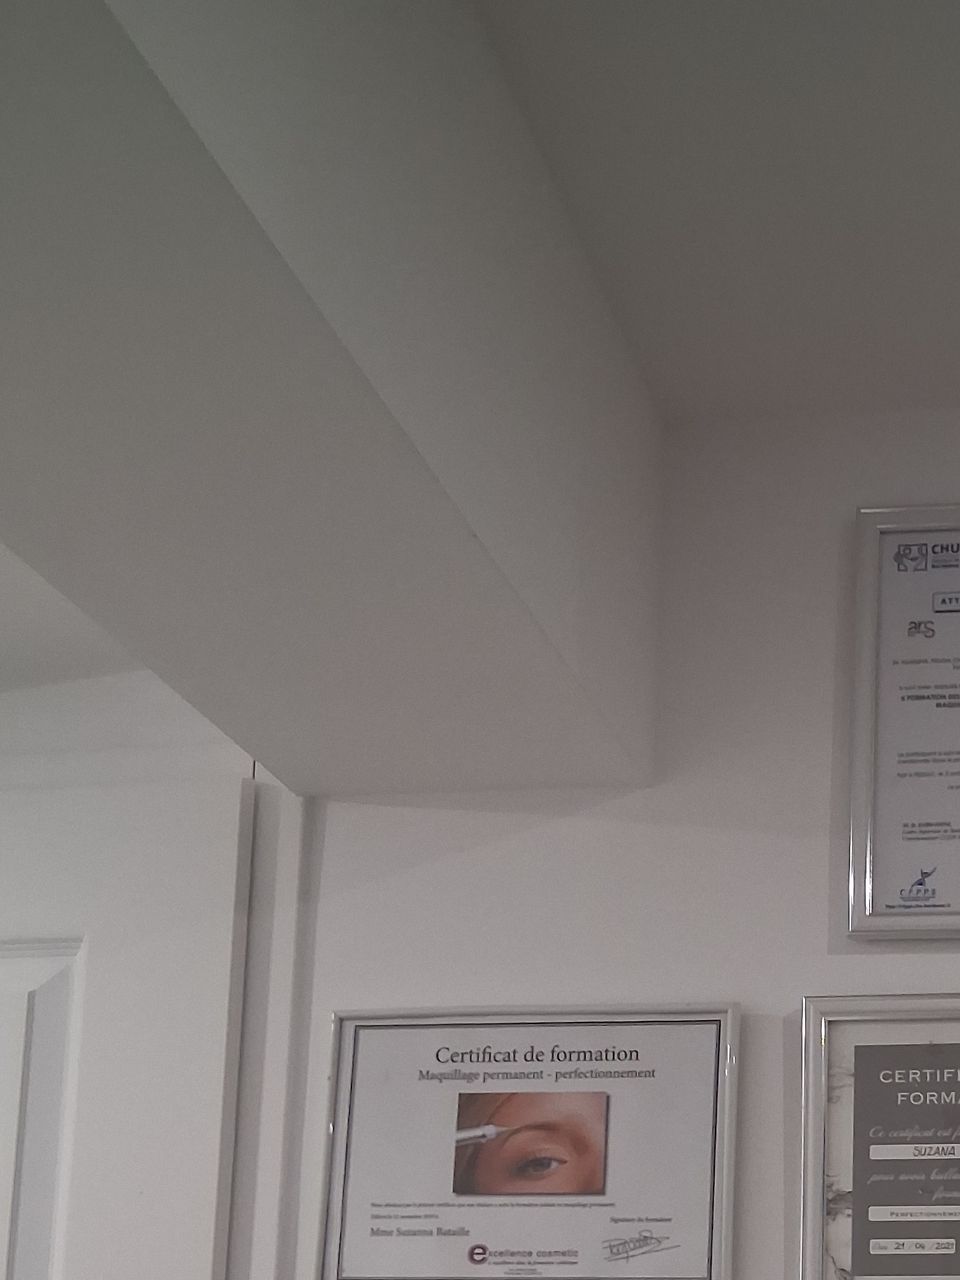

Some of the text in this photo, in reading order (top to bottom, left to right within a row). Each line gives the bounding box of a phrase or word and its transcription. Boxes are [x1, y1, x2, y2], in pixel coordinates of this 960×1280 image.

[931, 543, 960, 555] CHU
[907, 619, 936, 638] ars
[435, 1044, 640, 1065] Certificat de formation
[418, 1068, 480, 1084] Maquillage
[483, 1070, 543, 1083] permanent
[555, 1067, 655, 1082] perfectionnement
[912, 1144, 956, 1157] SUZANA
